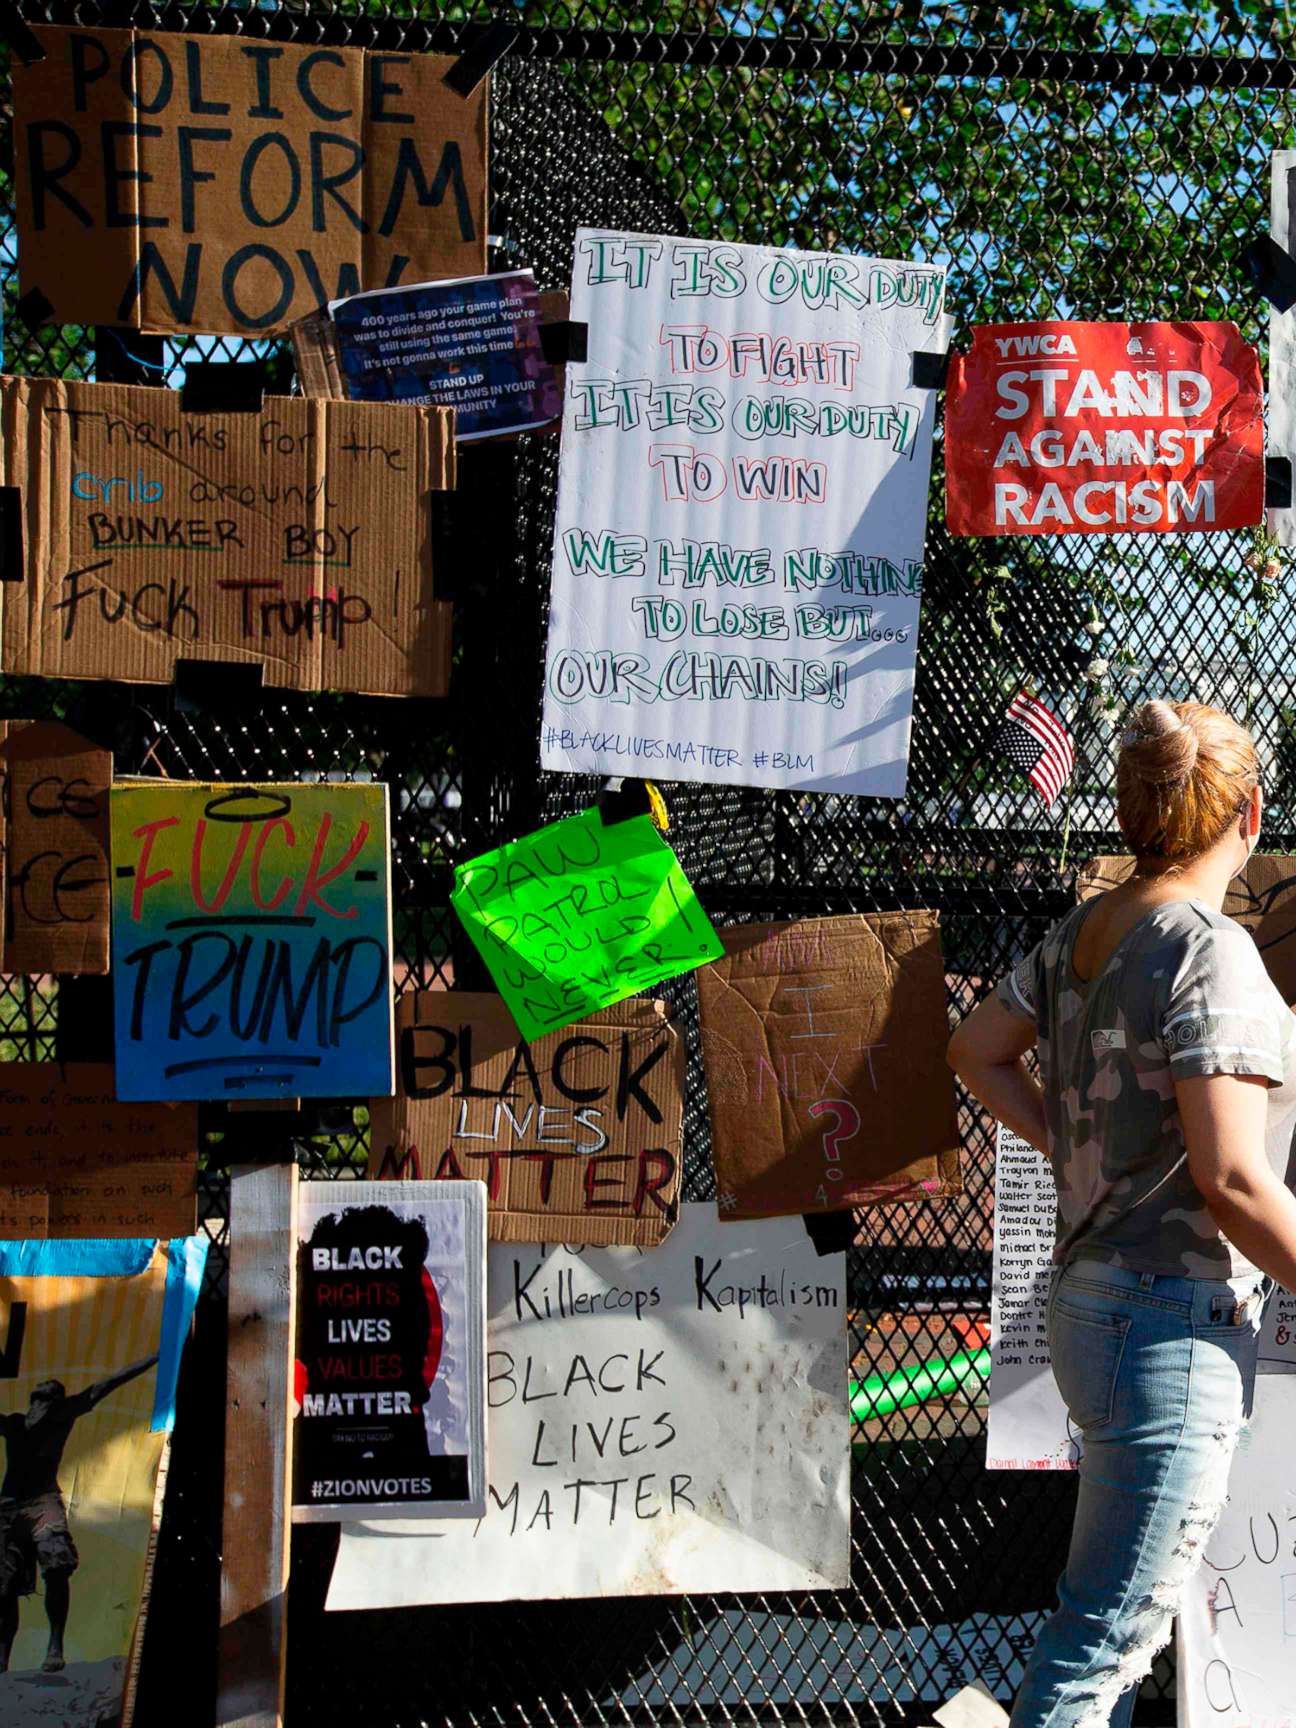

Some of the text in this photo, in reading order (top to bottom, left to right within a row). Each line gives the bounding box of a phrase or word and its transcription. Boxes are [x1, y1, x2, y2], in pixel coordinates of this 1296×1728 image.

[70, 34, 415, 124] POLICE
[26, 120, 475, 241] REFORM
[117, 241, 410, 329] NOW
[579, 237, 946, 326] IT IS OUR DUTY
[354, 309, 535, 342] was to divide and conquer! You're
[362, 297, 523, 327] 400 years ago your game plan
[364, 339, 513, 368] It's not gonna work this time
[379, 331, 481, 352] still using the same
[660, 323, 860, 390] TO FIGHT
[995, 334, 1077, 358] YWCA
[429, 374, 484, 390] STAND UP
[432, 380, 536, 403] THE LAWS IN YOUR
[995, 369, 1212, 420] STAND
[44, 408, 407, 471] Thanks for the
[571, 379, 920, 460] IT IS OUR DUTY
[994, 429, 1213, 468] AGAINST
[72, 470, 337, 508] crib around
[649, 443, 827, 503] TO WIN
[994, 479, 1215, 526] RACISM
[88, 512, 360, 565] BUNKER BOY
[562, 528, 647, 577] WE
[654, 538, 776, 588] HAVE
[632, 595, 686, 642] TO
[693, 599, 789, 640] LOSE
[551, 649, 848, 709] OUR CHAINS!
[542, 726, 814, 772] #BLACKLIVESMATTER #BLM
[131, 812, 370, 921] FUCK
[459, 826, 600, 920] PAW
[124, 931, 387, 1048] TRUMP
[401, 1024, 669, 1123] BLACK
[756, 1044, 888, 1104] NEXT
[453, 1100, 609, 1154] LIVES
[1000, 1155, 1037, 1164] Ahmaud
[1000, 1167, 1038, 1178] Trayvon
[378, 1144, 680, 1222] MATTER
[1000, 1179, 1029, 1189] Tamir
[1000, 1215, 1041, 1225] Amadou
[312, 1245, 403, 1271] BLACK
[1000, 1271, 1029, 1280] David
[317, 1282, 400, 1308] RIGHTS
[694, 1255, 838, 1319] Kapitalism
[998, 1298, 1030, 1309] Jamar
[1002, 1284, 1027, 1294] Sean
[327, 1318, 391, 1344] LIVES
[1000, 1324, 1030, 1333] Kevin
[1000, 1339, 1029, 1349] Keith
[317, 1356, 403, 1381] VALUES
[487, 1349, 667, 1409] BLACK
[997, 1355, 1022, 1366] John
[531, 1411, 677, 1467] LIVES
[311, 1477, 432, 1498] #ZIONVOTES
[473, 1473, 697, 1538] MATTER
